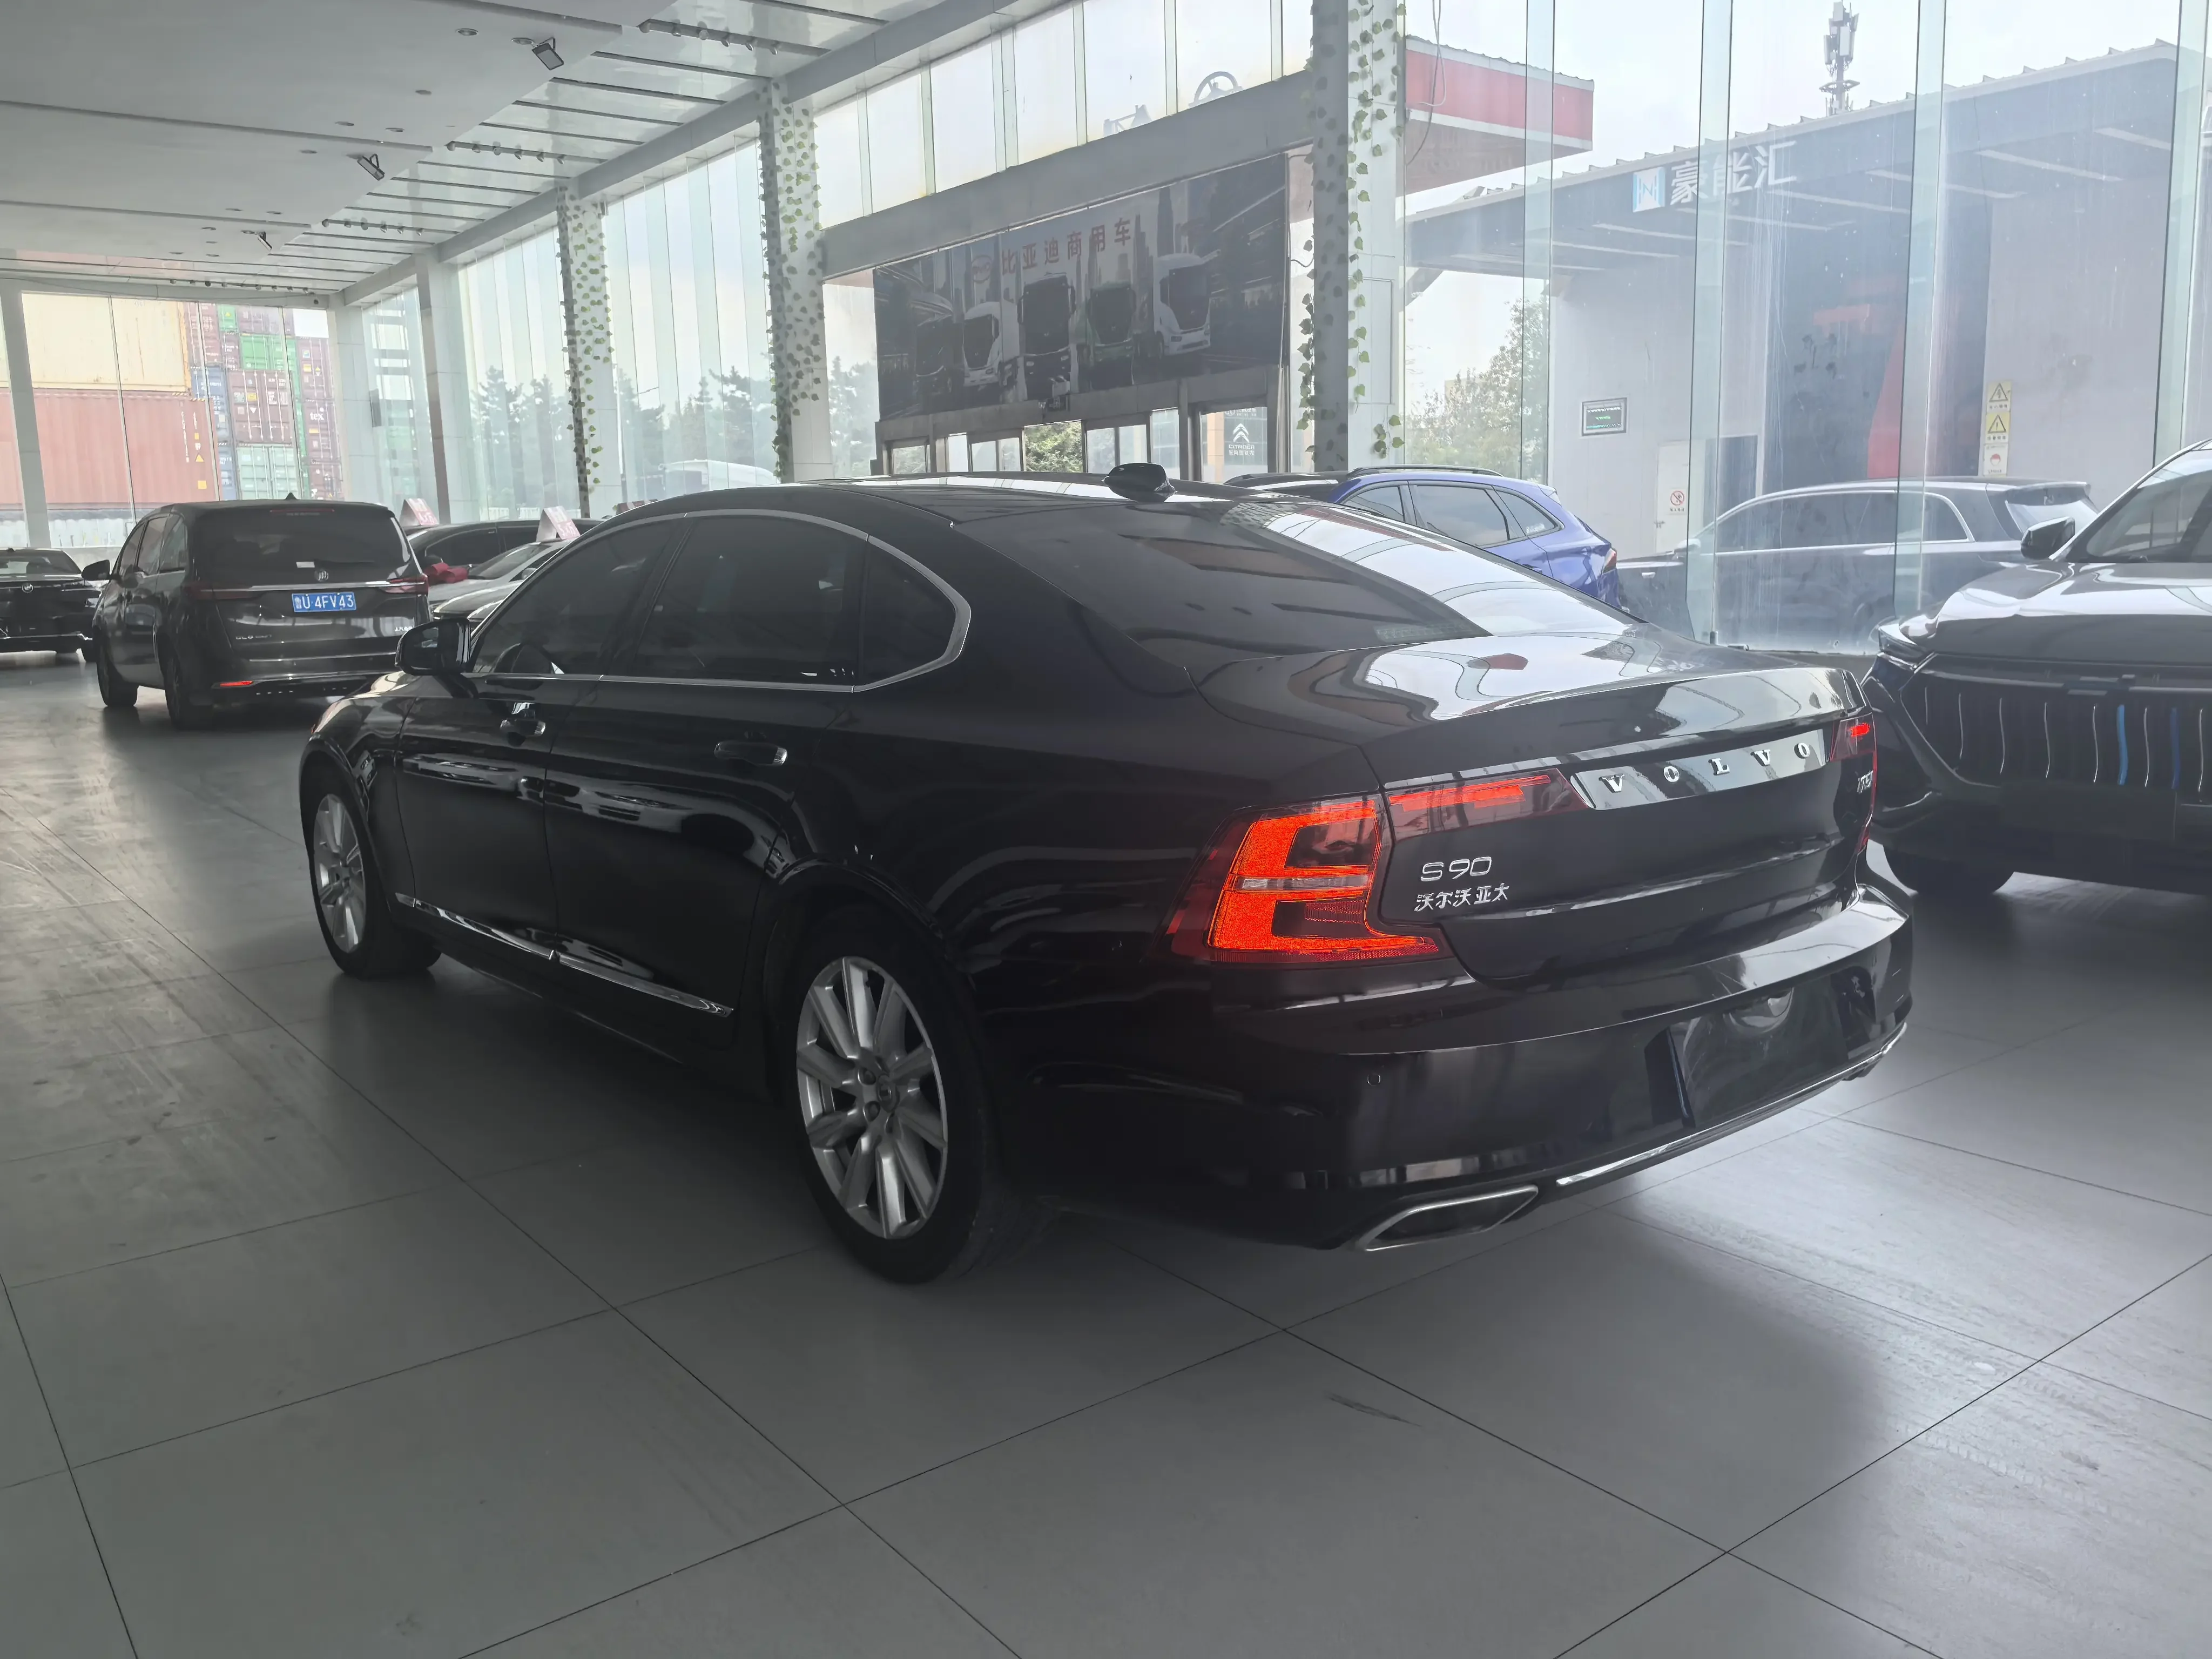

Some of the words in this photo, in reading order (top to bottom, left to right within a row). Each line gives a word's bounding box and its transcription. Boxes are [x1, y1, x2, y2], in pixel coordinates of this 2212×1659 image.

[1670, 139, 1797, 205] 豪能汇
[1001, 217, 1131, 276] 比亚迪商用车
[1599, 742, 1812, 793] VOLVO
[1414, 883, 1509, 912] 沃尔沃亚太
